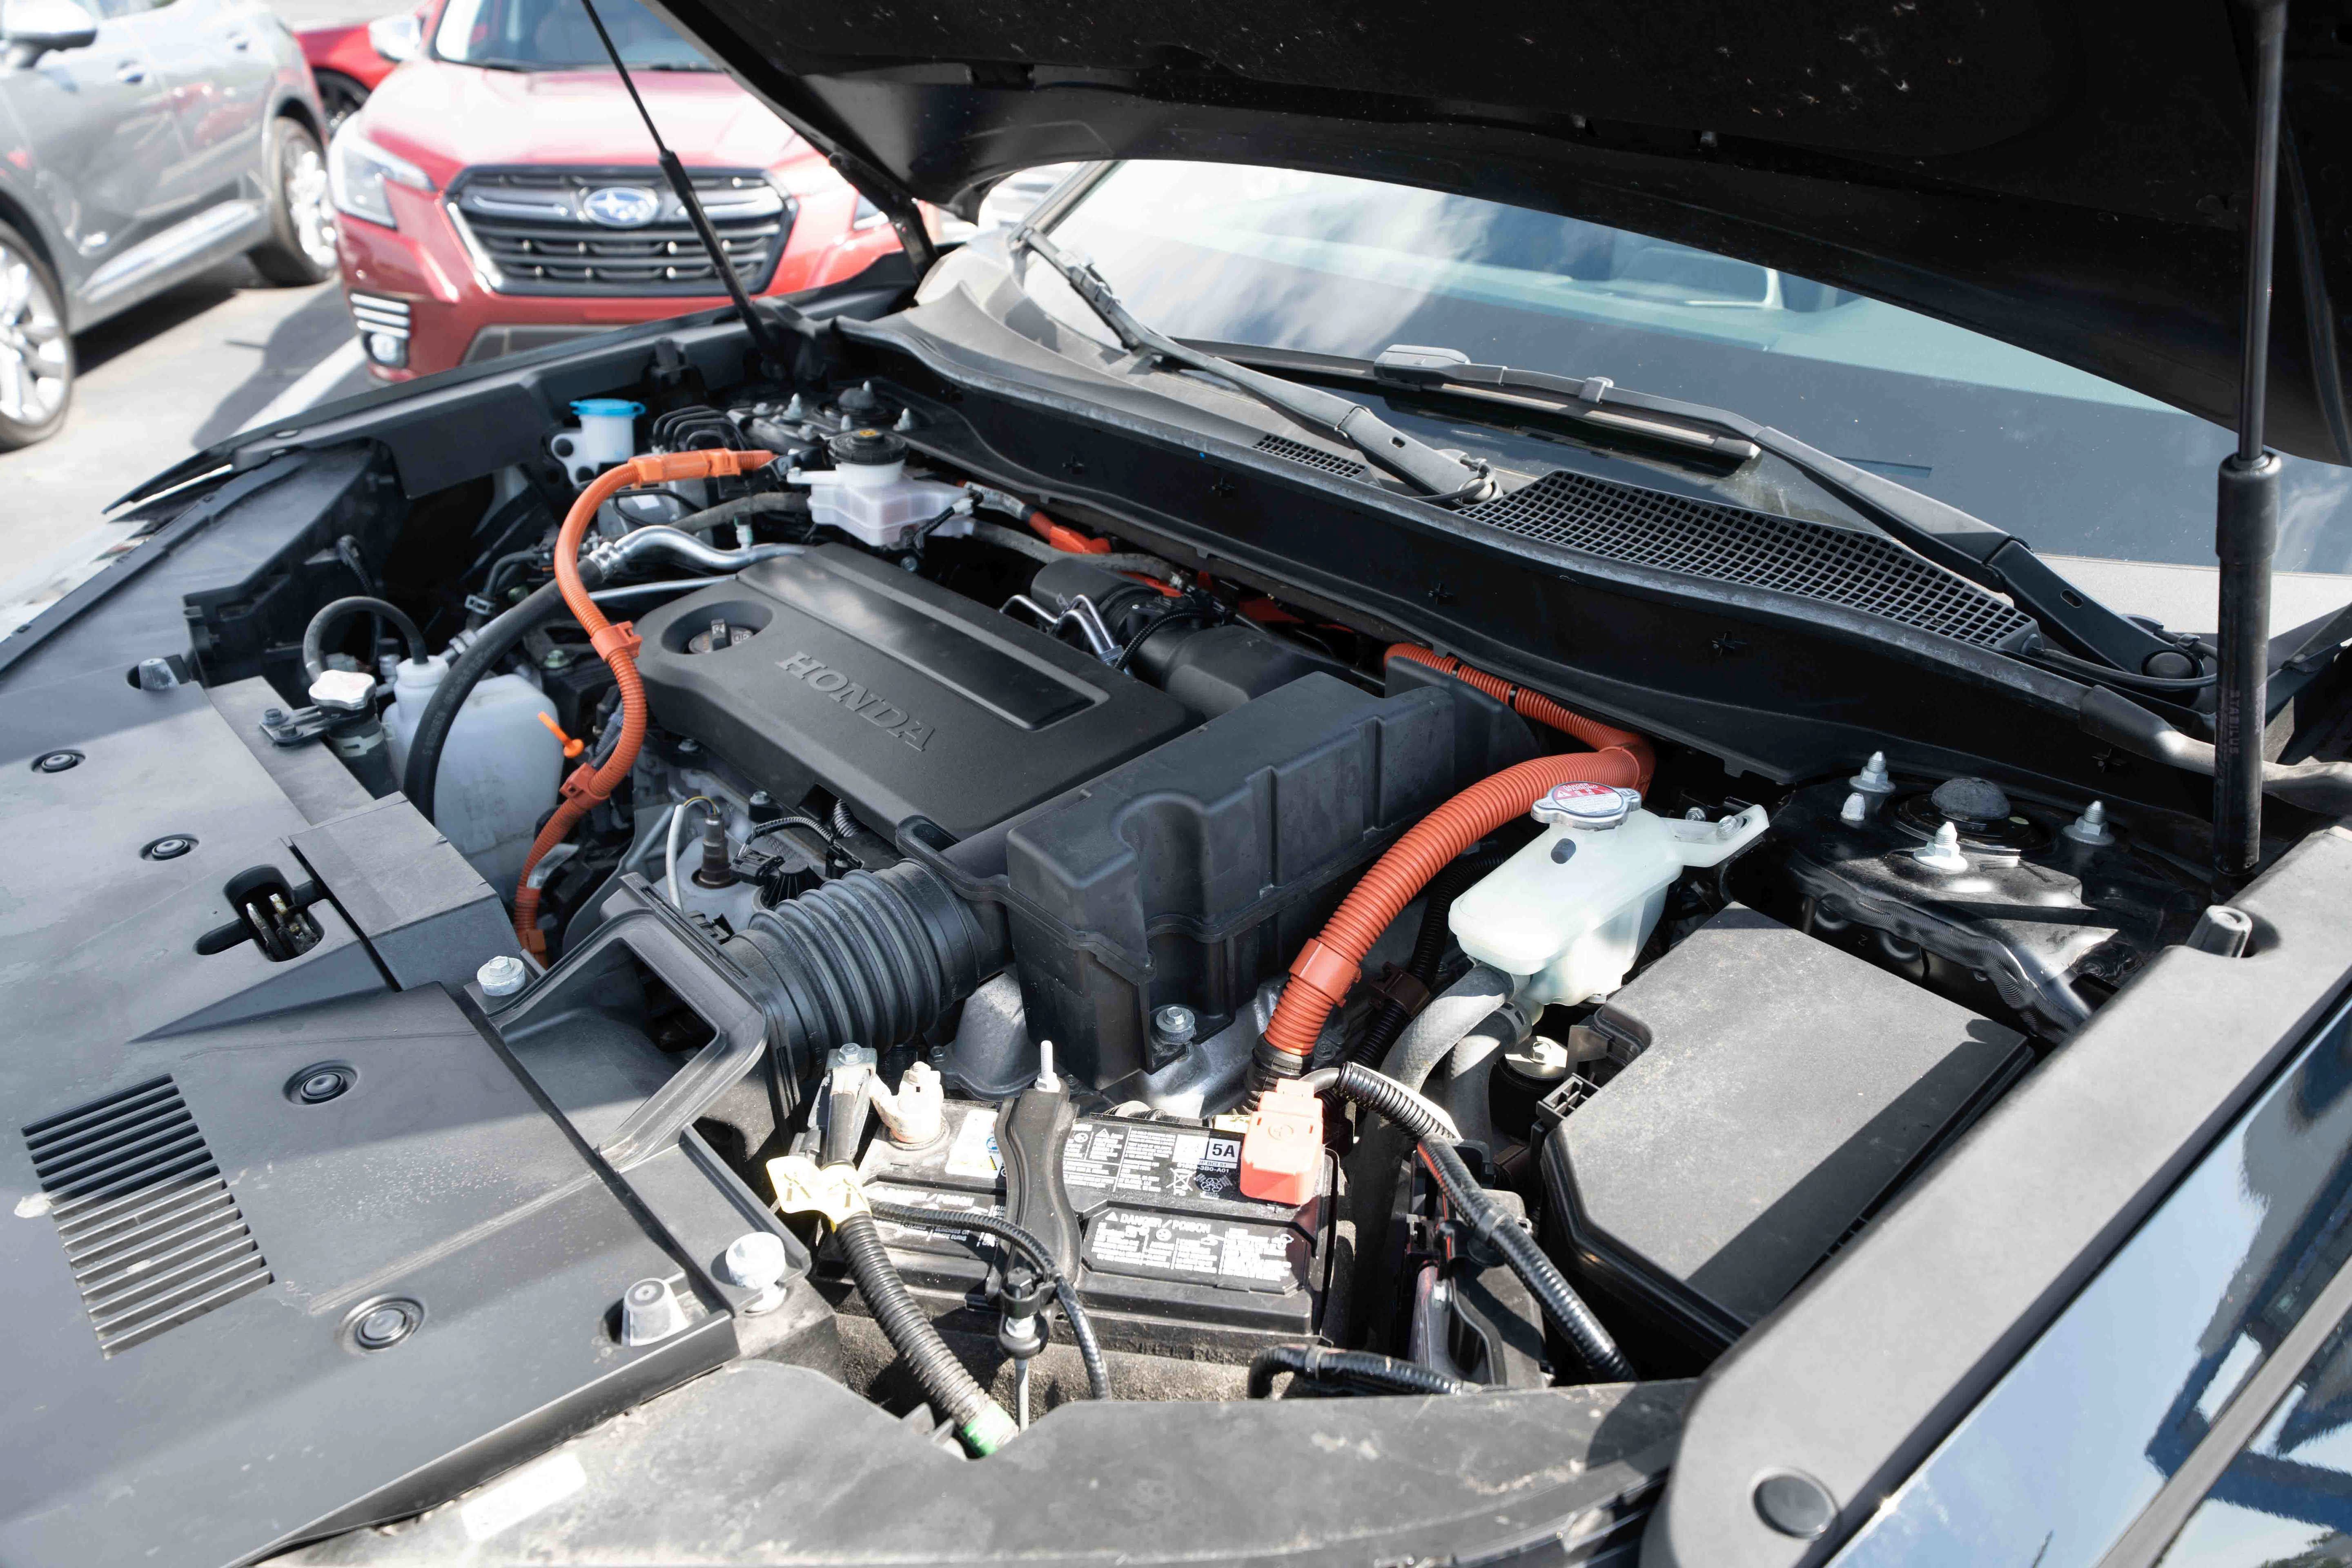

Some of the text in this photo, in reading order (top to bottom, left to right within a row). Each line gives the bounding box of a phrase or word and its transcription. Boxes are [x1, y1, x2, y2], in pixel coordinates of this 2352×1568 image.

[775, 651, 935, 752] HONDA
[1212, 1143, 1235, 1158] 5A
[1120, 1214, 1162, 1228] DANGER
[1172, 1220, 1211, 1233] POISON
